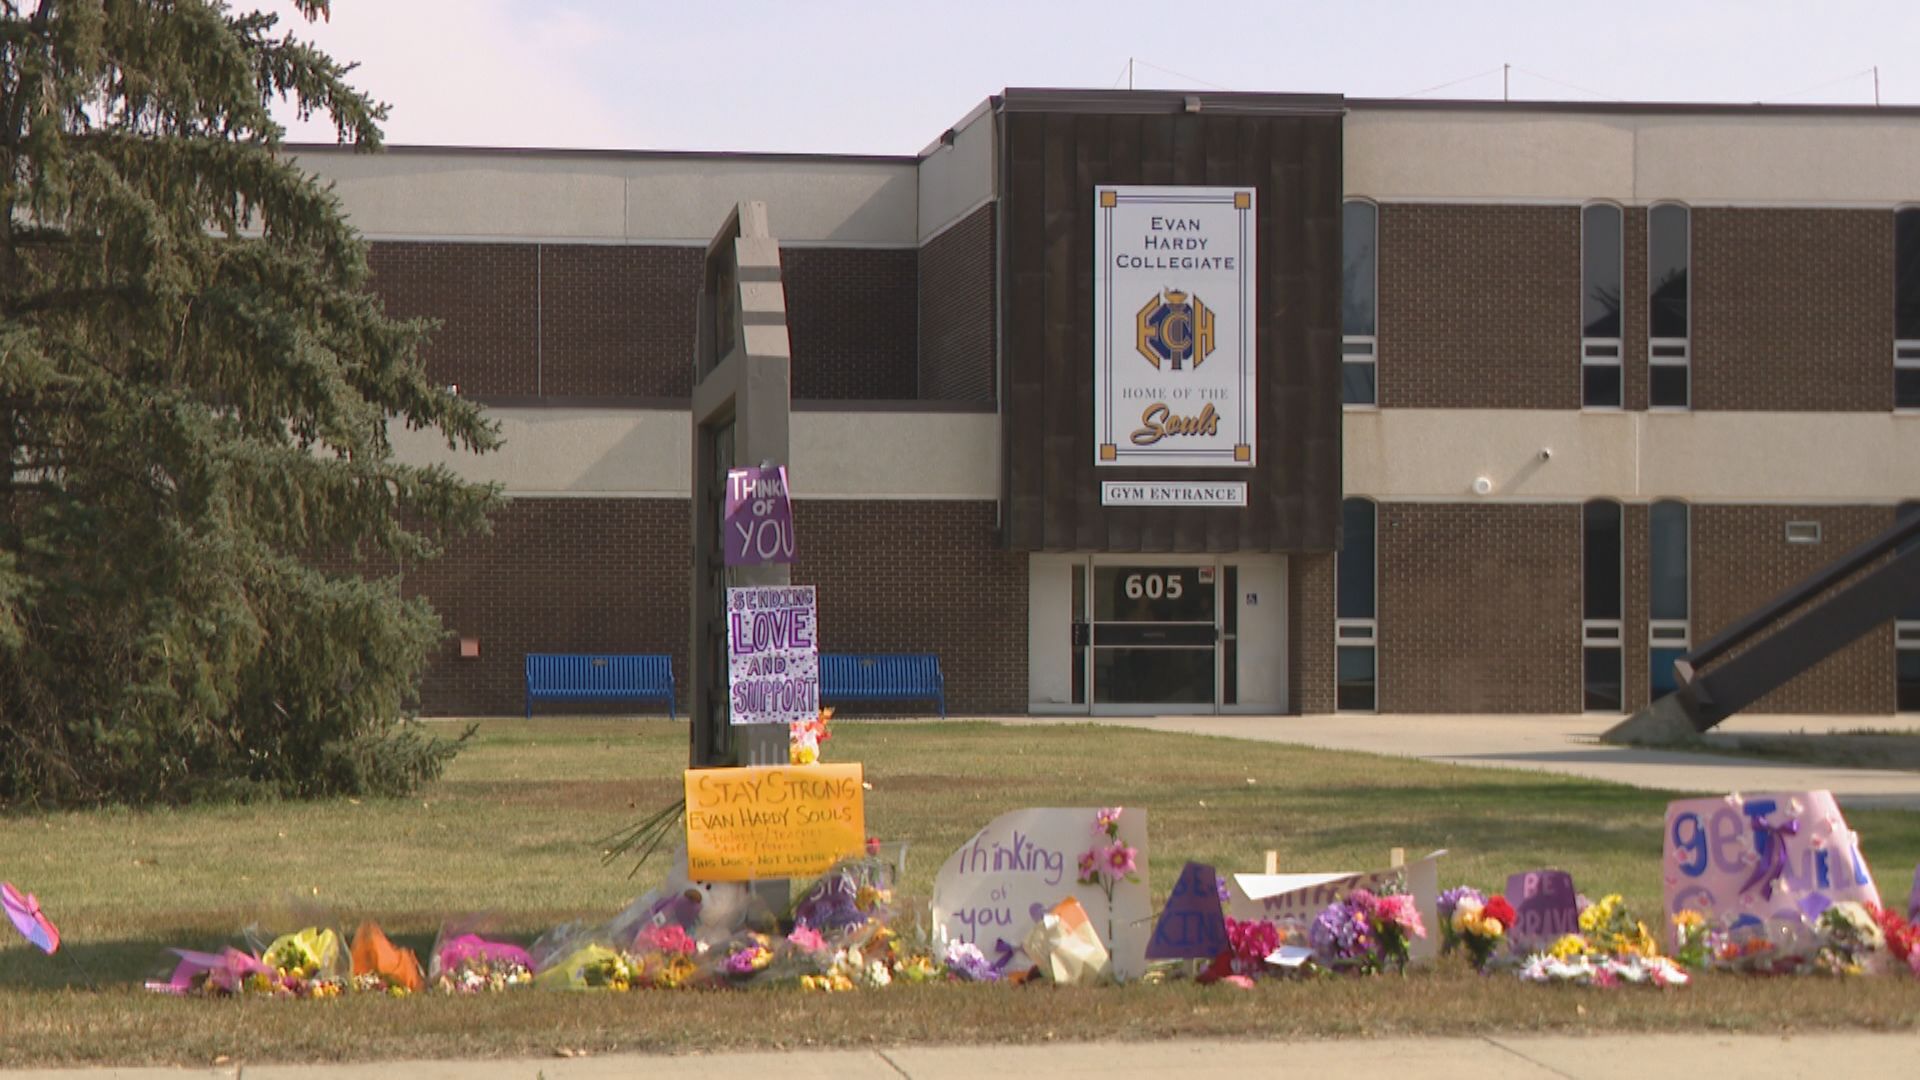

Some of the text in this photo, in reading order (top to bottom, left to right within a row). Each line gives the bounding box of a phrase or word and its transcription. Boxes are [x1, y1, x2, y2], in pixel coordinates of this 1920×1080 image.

[1150, 216, 1201, 231] EVAN
[1144, 235, 1209, 250] HARDY
[1115, 254, 1236, 270] COLLEGIATE
[1122, 387, 1229, 400] HOME OF THE
[1130, 402, 1221, 446] Souls
[1110, 487, 1237, 501] GYM ENTRANCE
[752, 499, 776, 517] OF
[735, 518, 795, 559] YOU
[1125, 574, 1184, 599] 605
[733, 589, 814, 610] SENDING
[732, 607, 812, 655] LOVE
[747, 656, 787, 676] AND
[733, 677, 817, 714] SUPPORT
[699, 771, 856, 808] STAY STRONG
[689, 804, 853, 831] EVAN HARDY SOULS
[953, 904, 1013, 945] you
